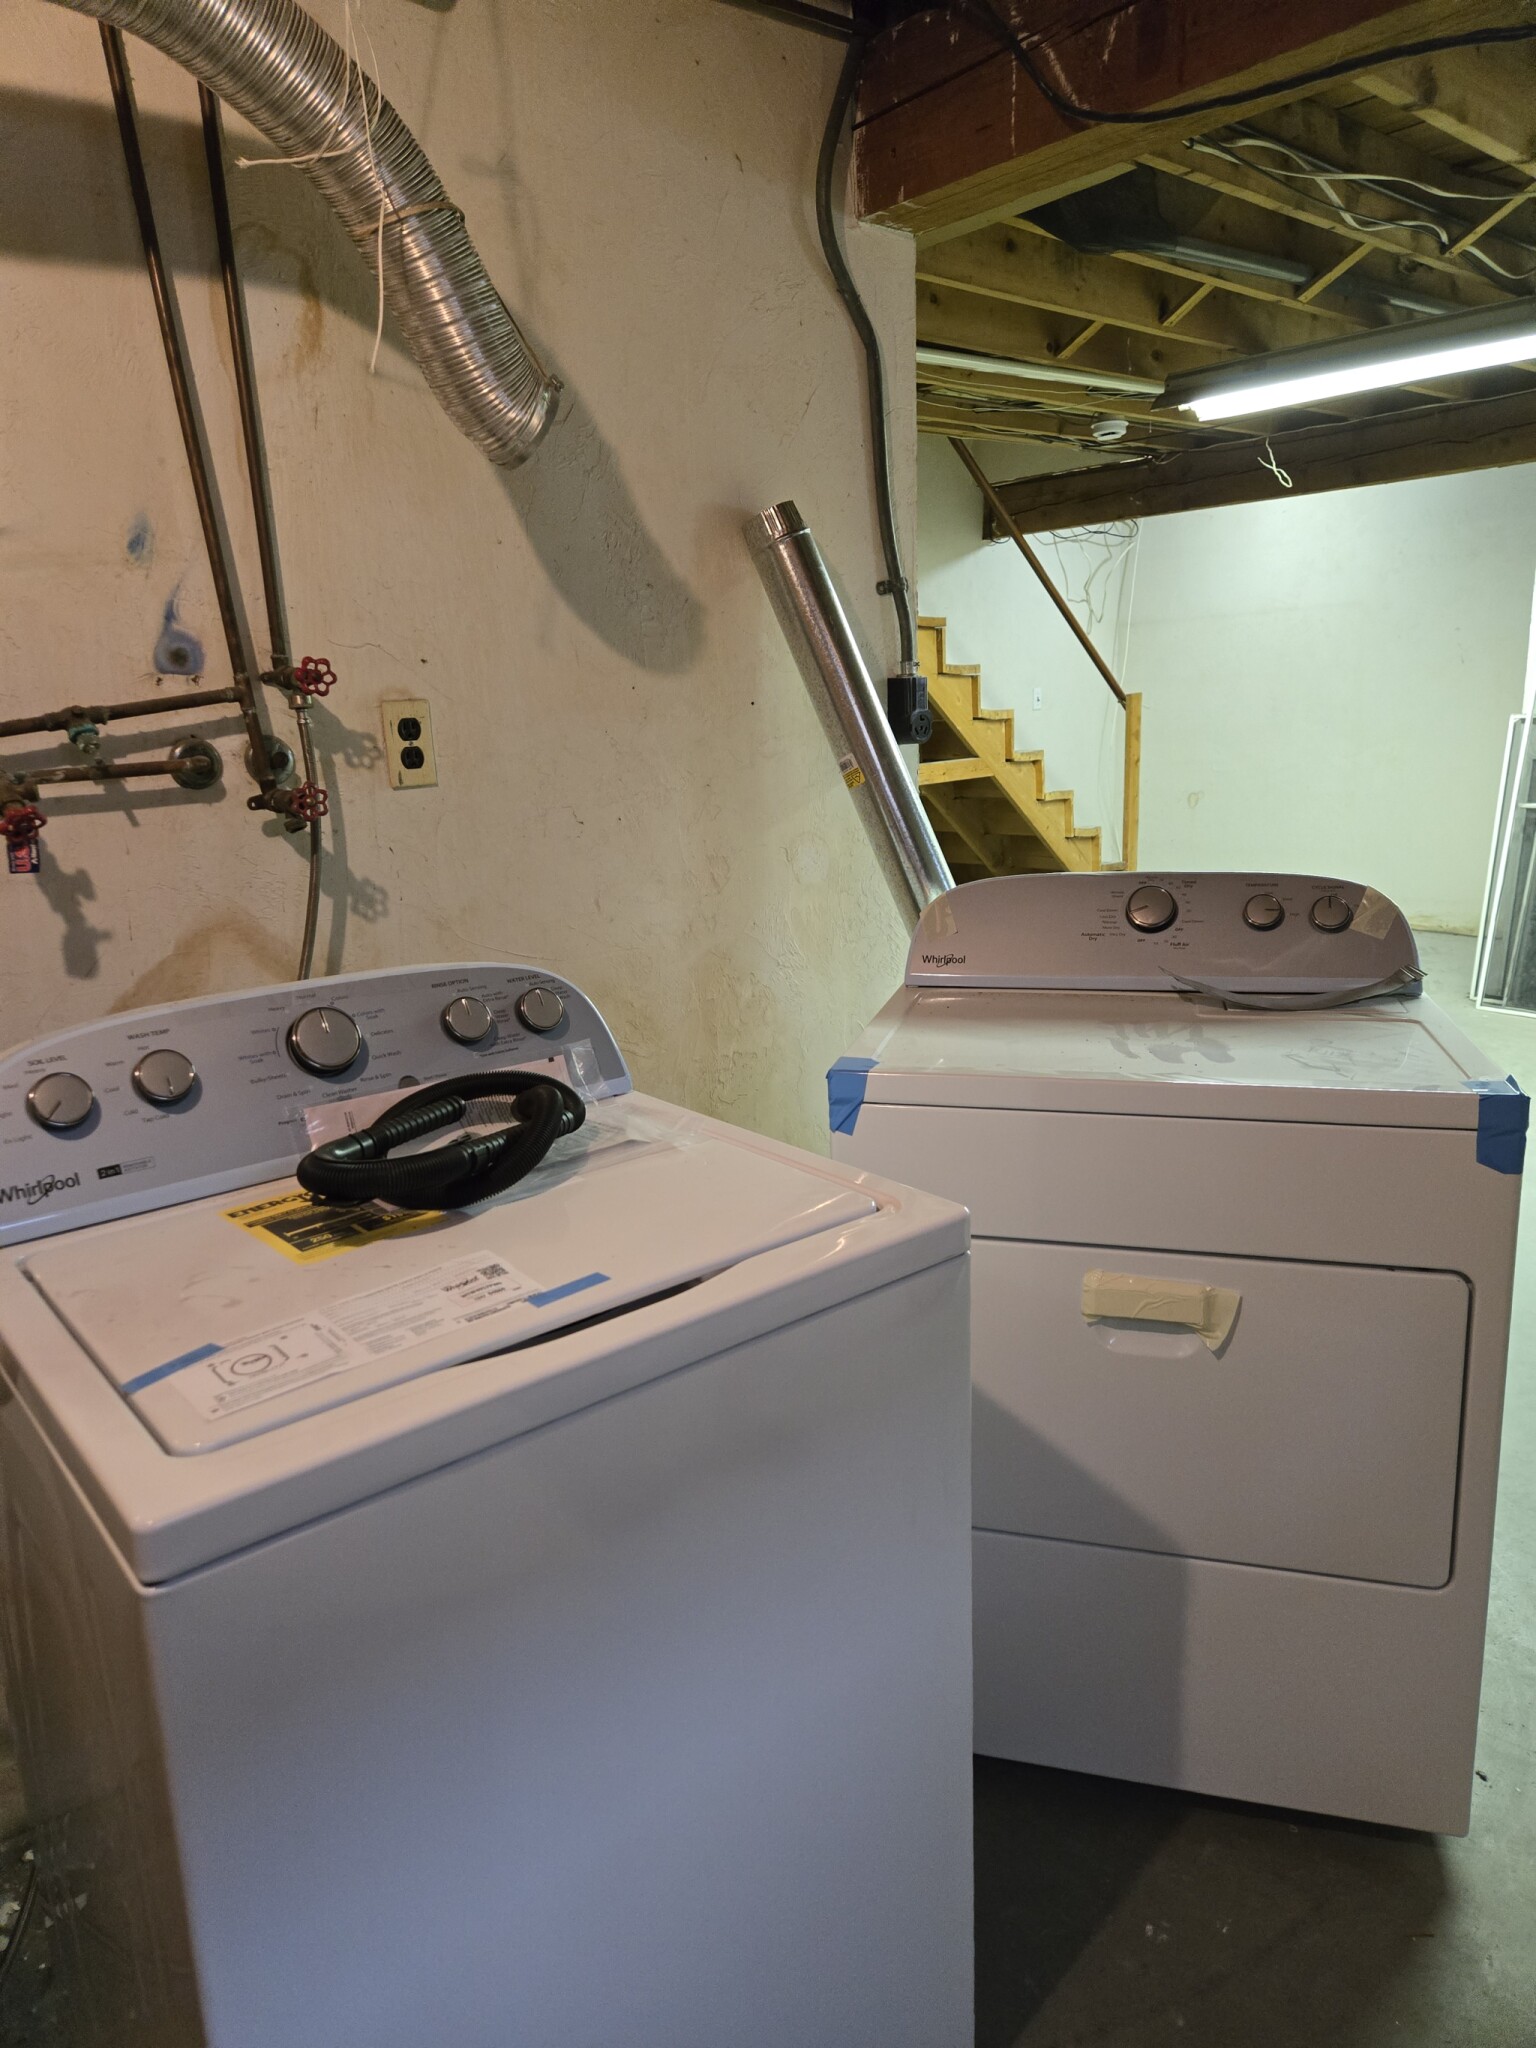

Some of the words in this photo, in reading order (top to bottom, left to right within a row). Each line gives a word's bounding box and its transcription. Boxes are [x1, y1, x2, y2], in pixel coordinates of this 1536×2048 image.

[921, 953, 966, 968] Whirlpool
[127, 1031, 150, 1040] WASH
[150, 1028, 170, 1036] TEMP
[0, 1172, 81, 1205] Whirlpool
